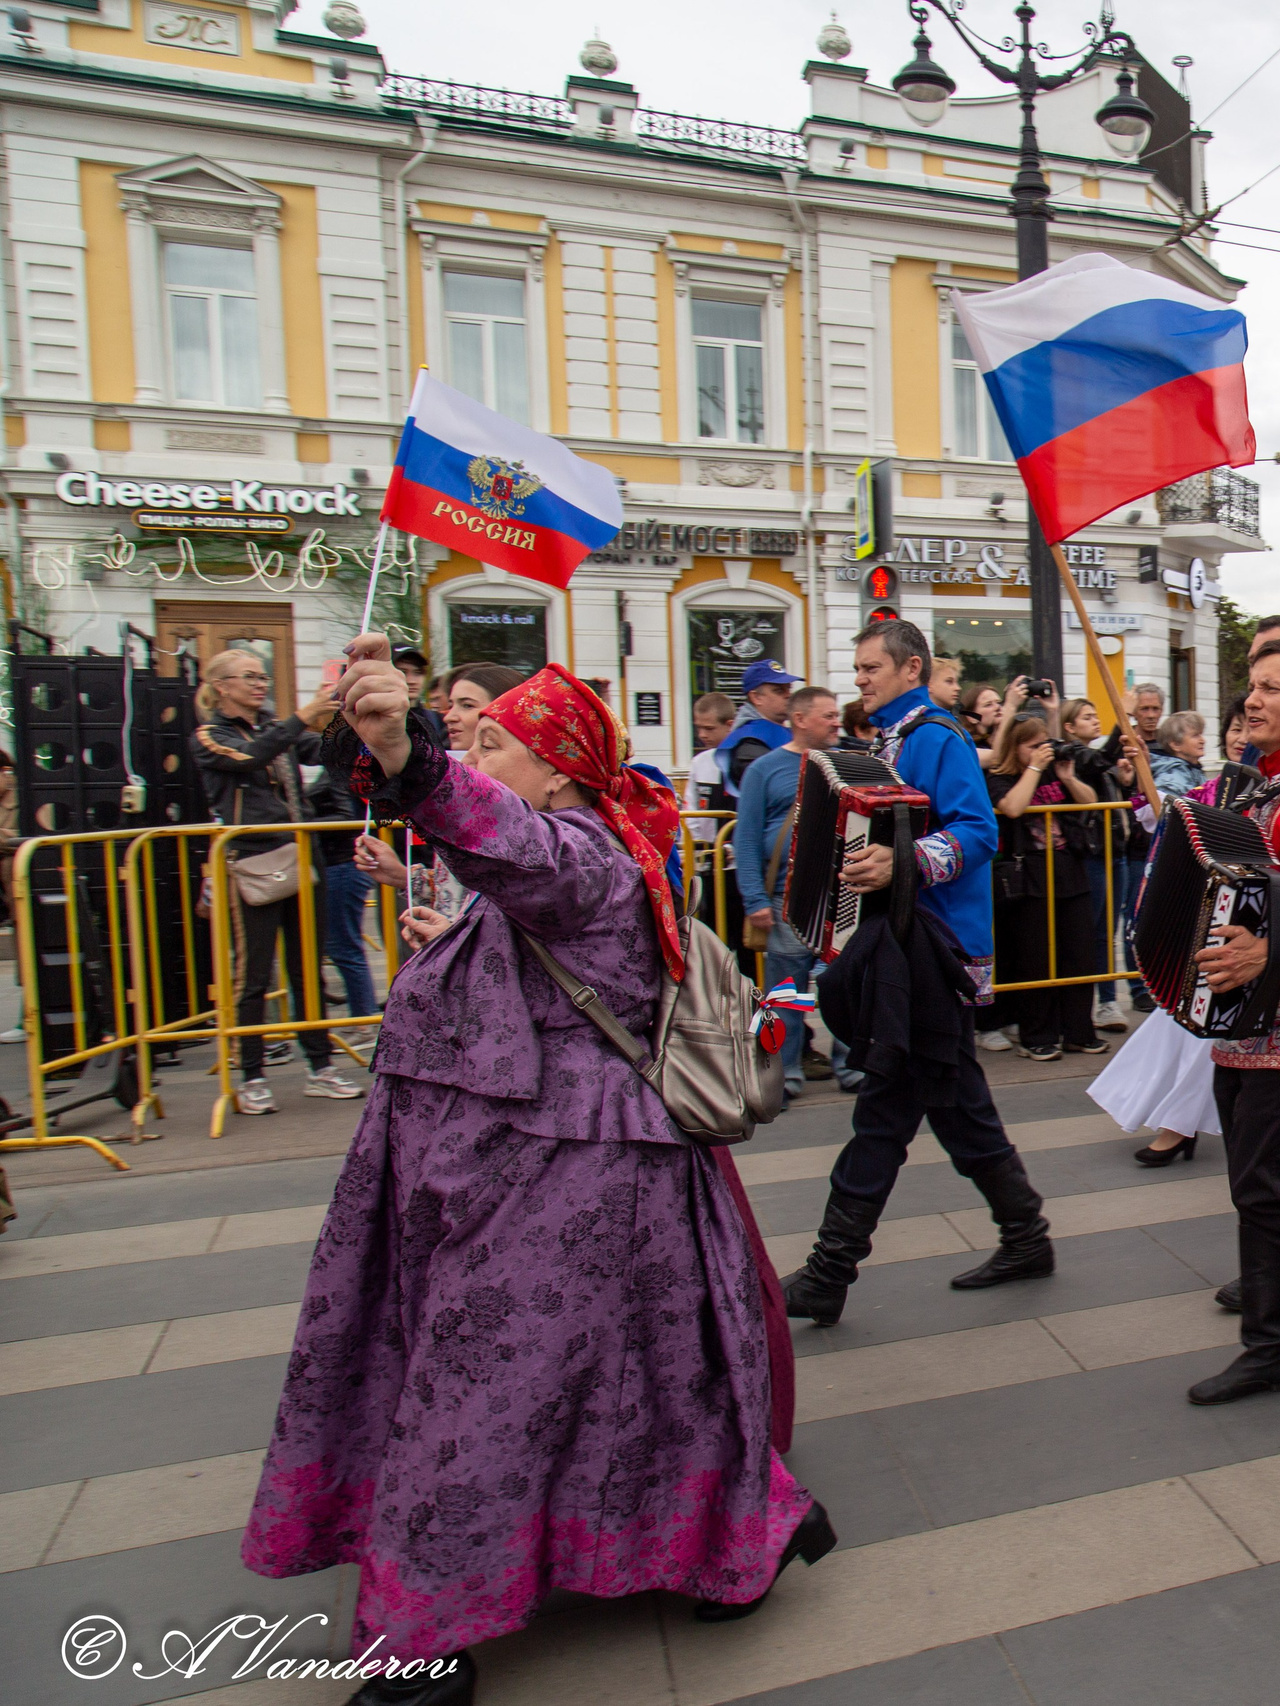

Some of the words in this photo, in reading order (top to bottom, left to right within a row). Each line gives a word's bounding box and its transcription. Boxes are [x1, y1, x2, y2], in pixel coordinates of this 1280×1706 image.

[55, 470, 221, 510] Cheese
[230, 479, 361, 517] Knock
[431, 501, 537, 551] РОССИЯ
[670, 524, 740, 554] МОСТ
[653, 556, 679, 566] БАР
[836, 566, 973, 583] КОТЕРСКАЯ
[841, 535, 968, 563] ЭЛЕР
[976, 544, 1012, 579] &
